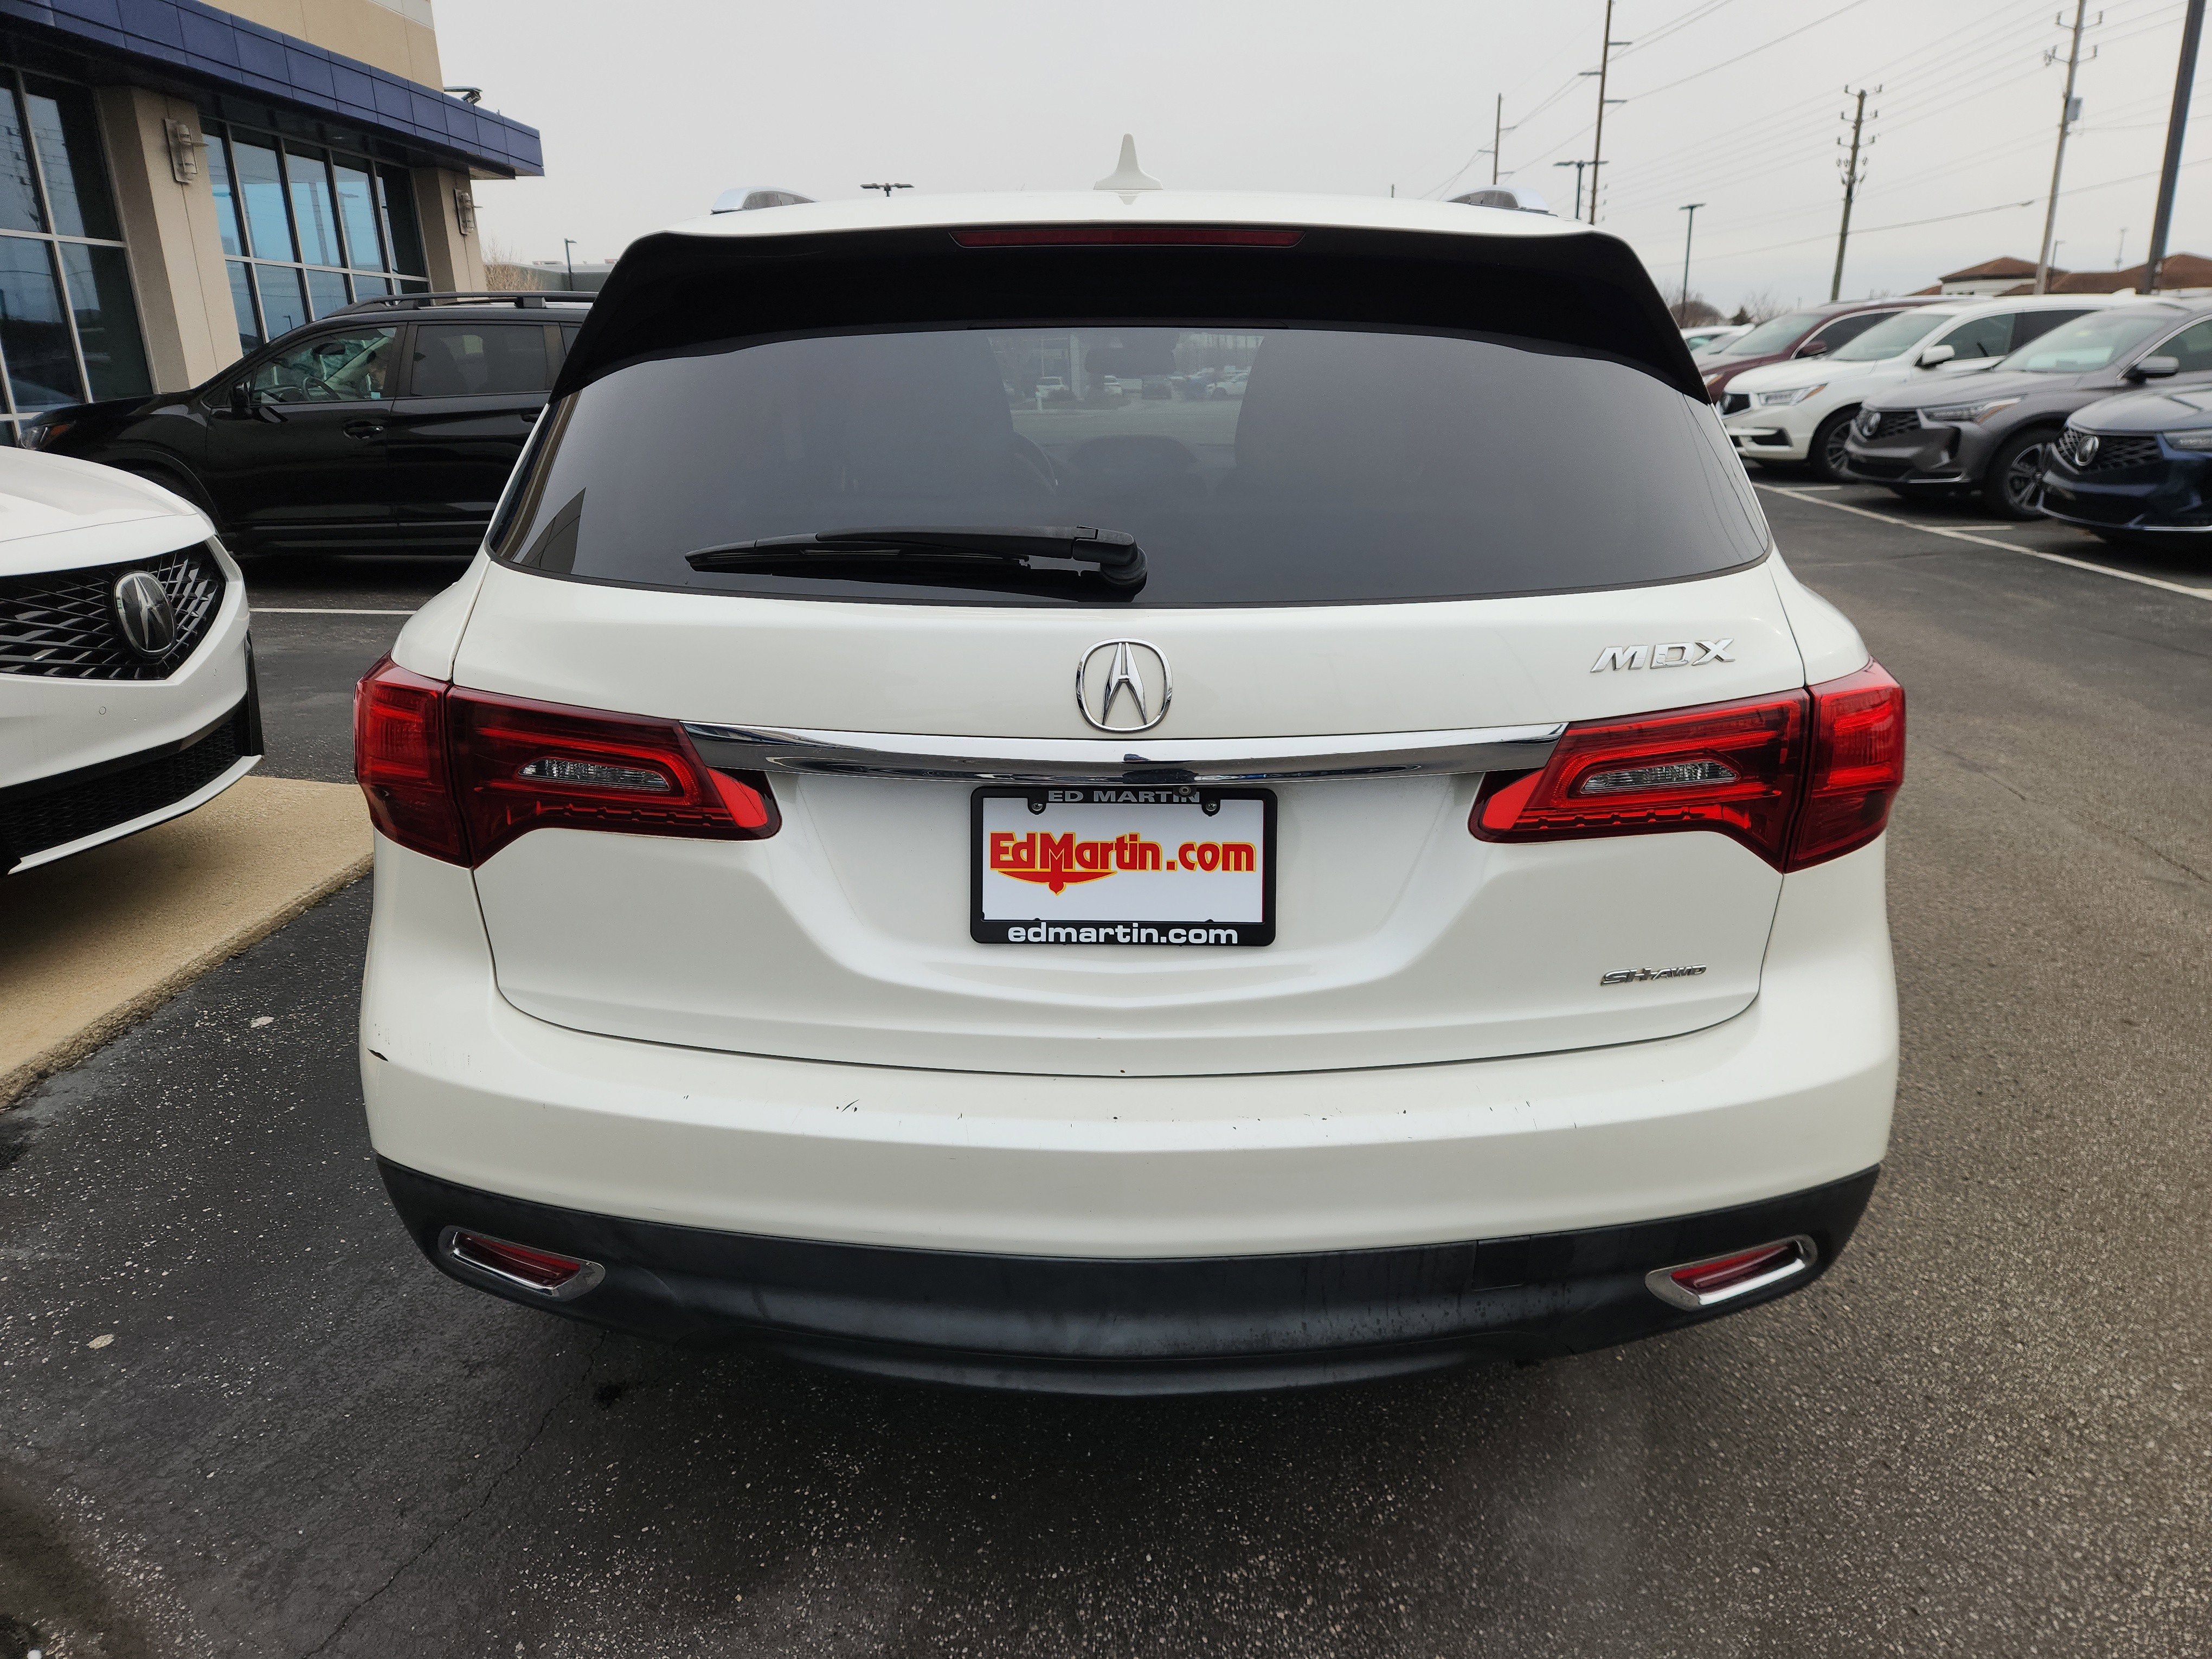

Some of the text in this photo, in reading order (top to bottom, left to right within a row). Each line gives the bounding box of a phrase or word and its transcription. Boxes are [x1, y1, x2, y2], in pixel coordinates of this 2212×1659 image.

[1590, 638, 1737, 673] MDX
[1048, 790, 1084, 802] ED
[1007, 922, 1238, 944] edmartin.com
[1600, 964, 1707, 987] SH-AWD
